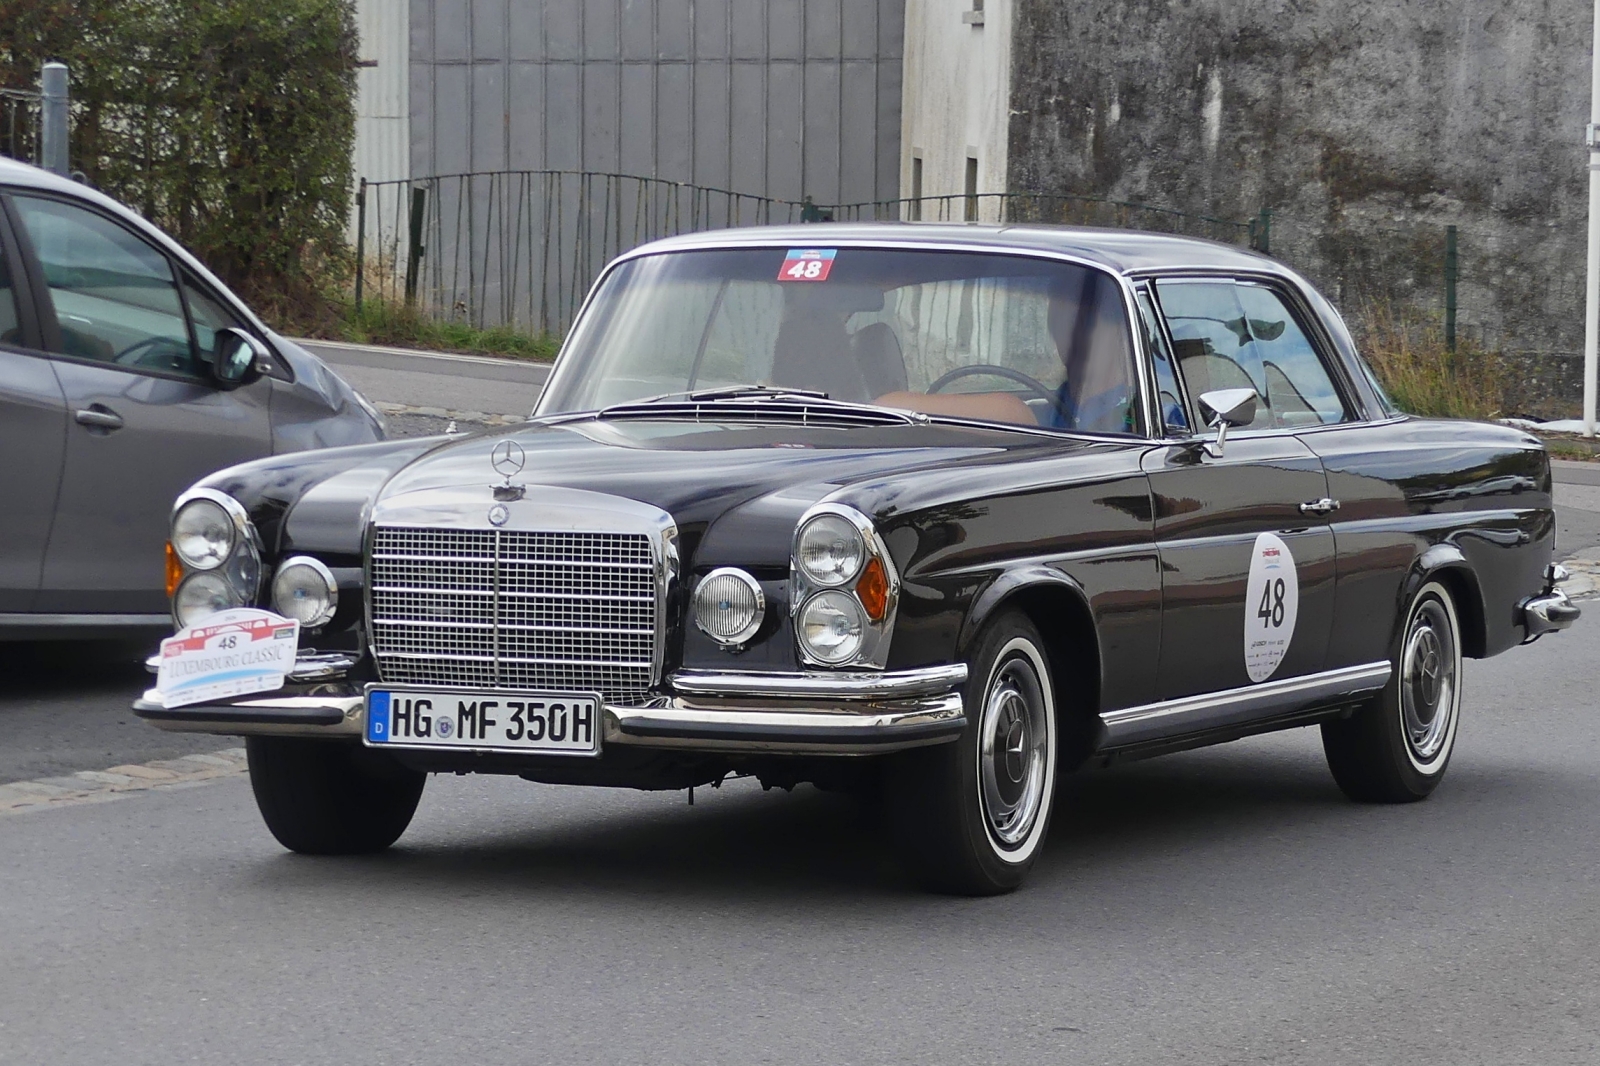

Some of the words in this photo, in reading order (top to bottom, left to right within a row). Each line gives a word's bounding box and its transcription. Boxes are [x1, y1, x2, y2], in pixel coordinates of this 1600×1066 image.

[787, 260, 822, 278] 48
[1258, 578, 1285, 628] 48
[218, 635, 237, 650] 48
[169, 652, 240, 678] LUXEMBOURG
[241, 643, 285, 666] CLASSIC
[375, 723, 383, 733] D
[392, 699, 432, 738] HG
[457, 701, 498, 739] MF
[505, 702, 592, 742] 350H
